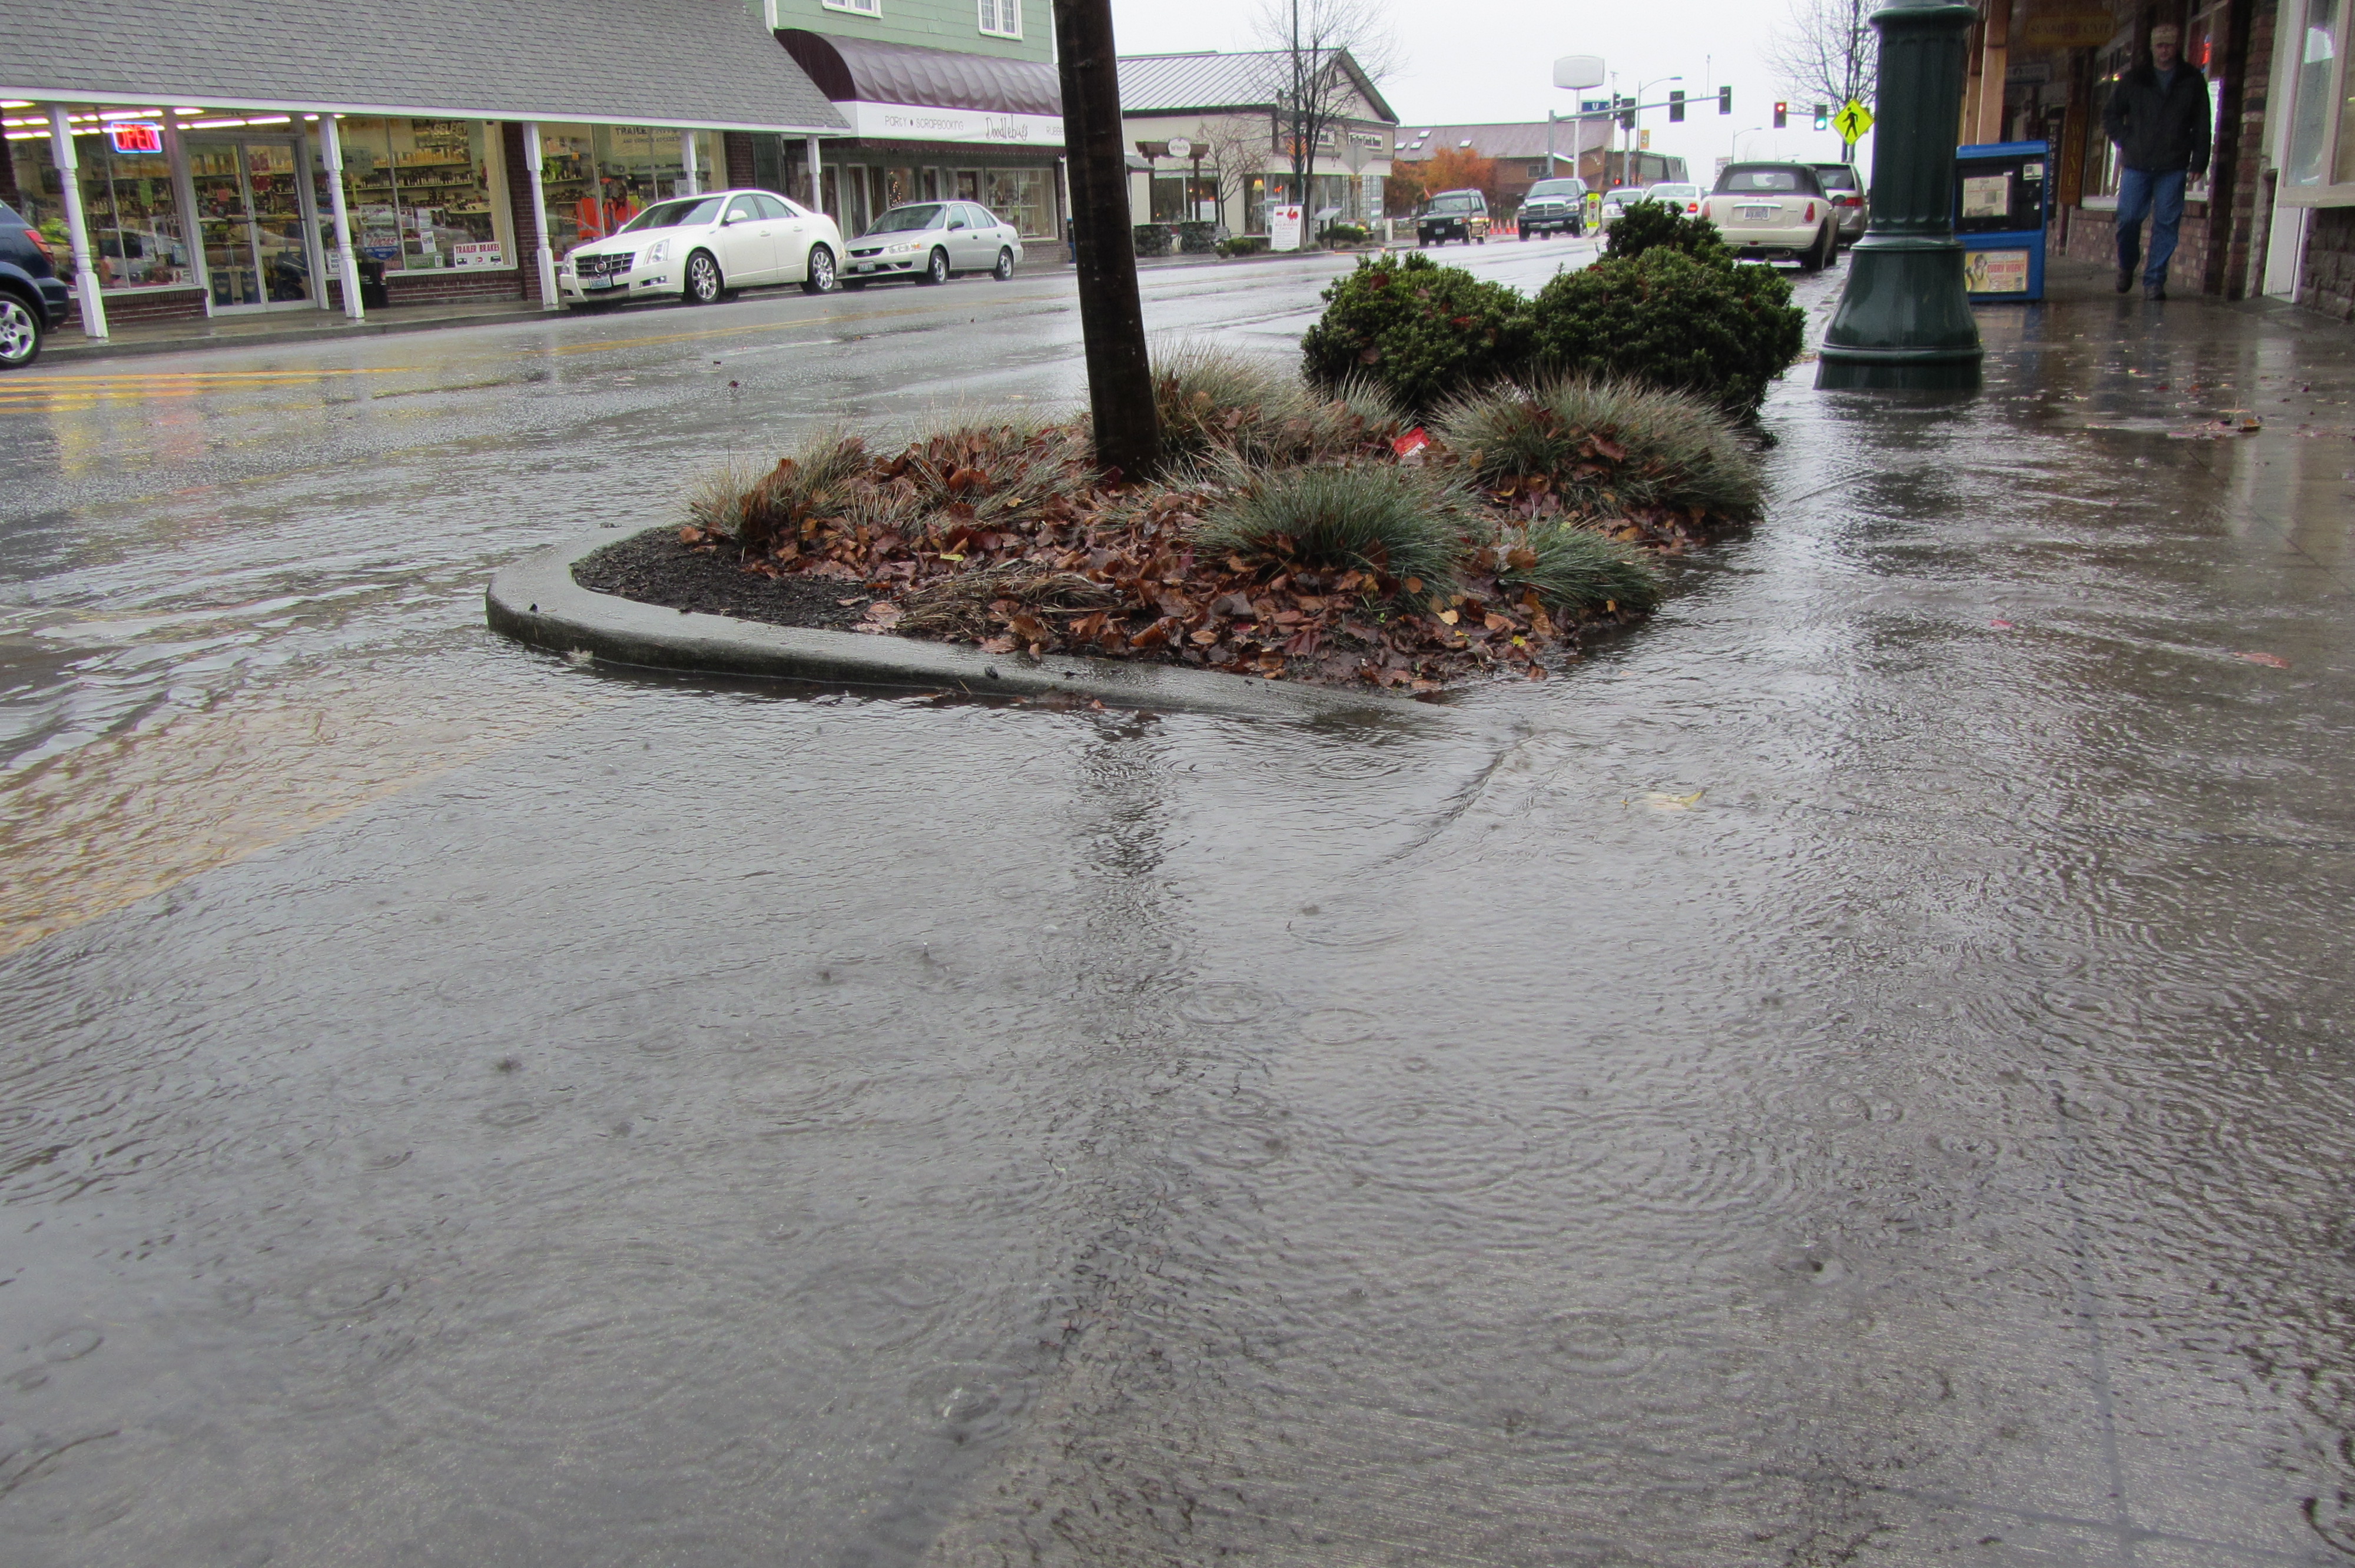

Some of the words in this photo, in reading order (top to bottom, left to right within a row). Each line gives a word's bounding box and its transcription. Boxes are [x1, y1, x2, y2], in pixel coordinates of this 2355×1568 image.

[114, 124, 159, 150] OPEN
[986, 115, 1028, 141] Doodlebugs
[2066, 123, 2081, 186] WINE
[369, 237, 396, 246] LUCAS
[455, 245, 477, 254] TRAILER
[479, 243, 500, 253] BRAKES
